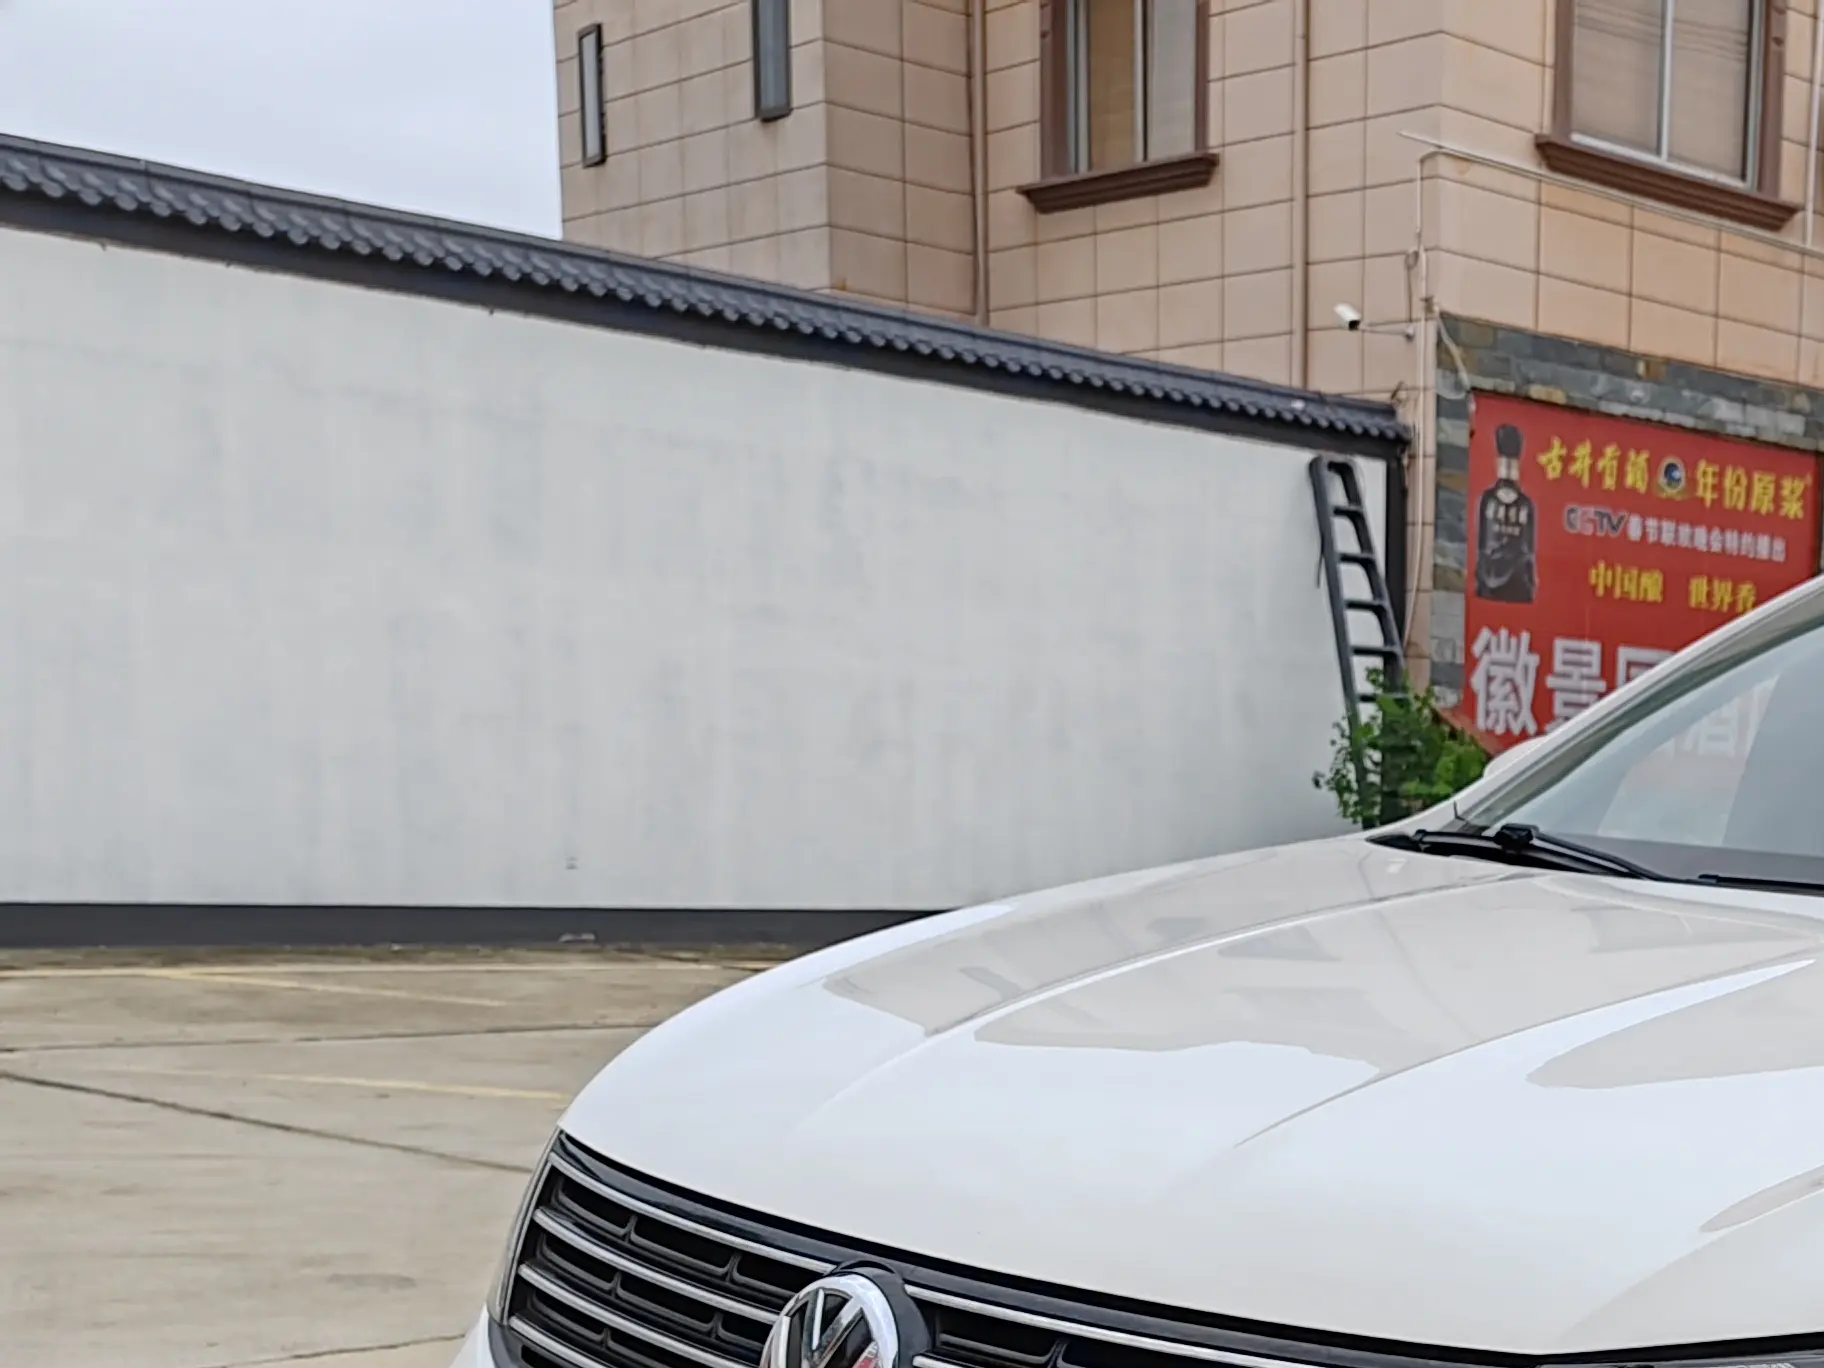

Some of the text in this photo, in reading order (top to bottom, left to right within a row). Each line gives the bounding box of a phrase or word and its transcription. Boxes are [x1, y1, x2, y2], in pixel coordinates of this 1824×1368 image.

[1536, 435, 1806, 519] 古井贡酒 年份原浆
[1588, 560, 1664, 603] 中国酿
